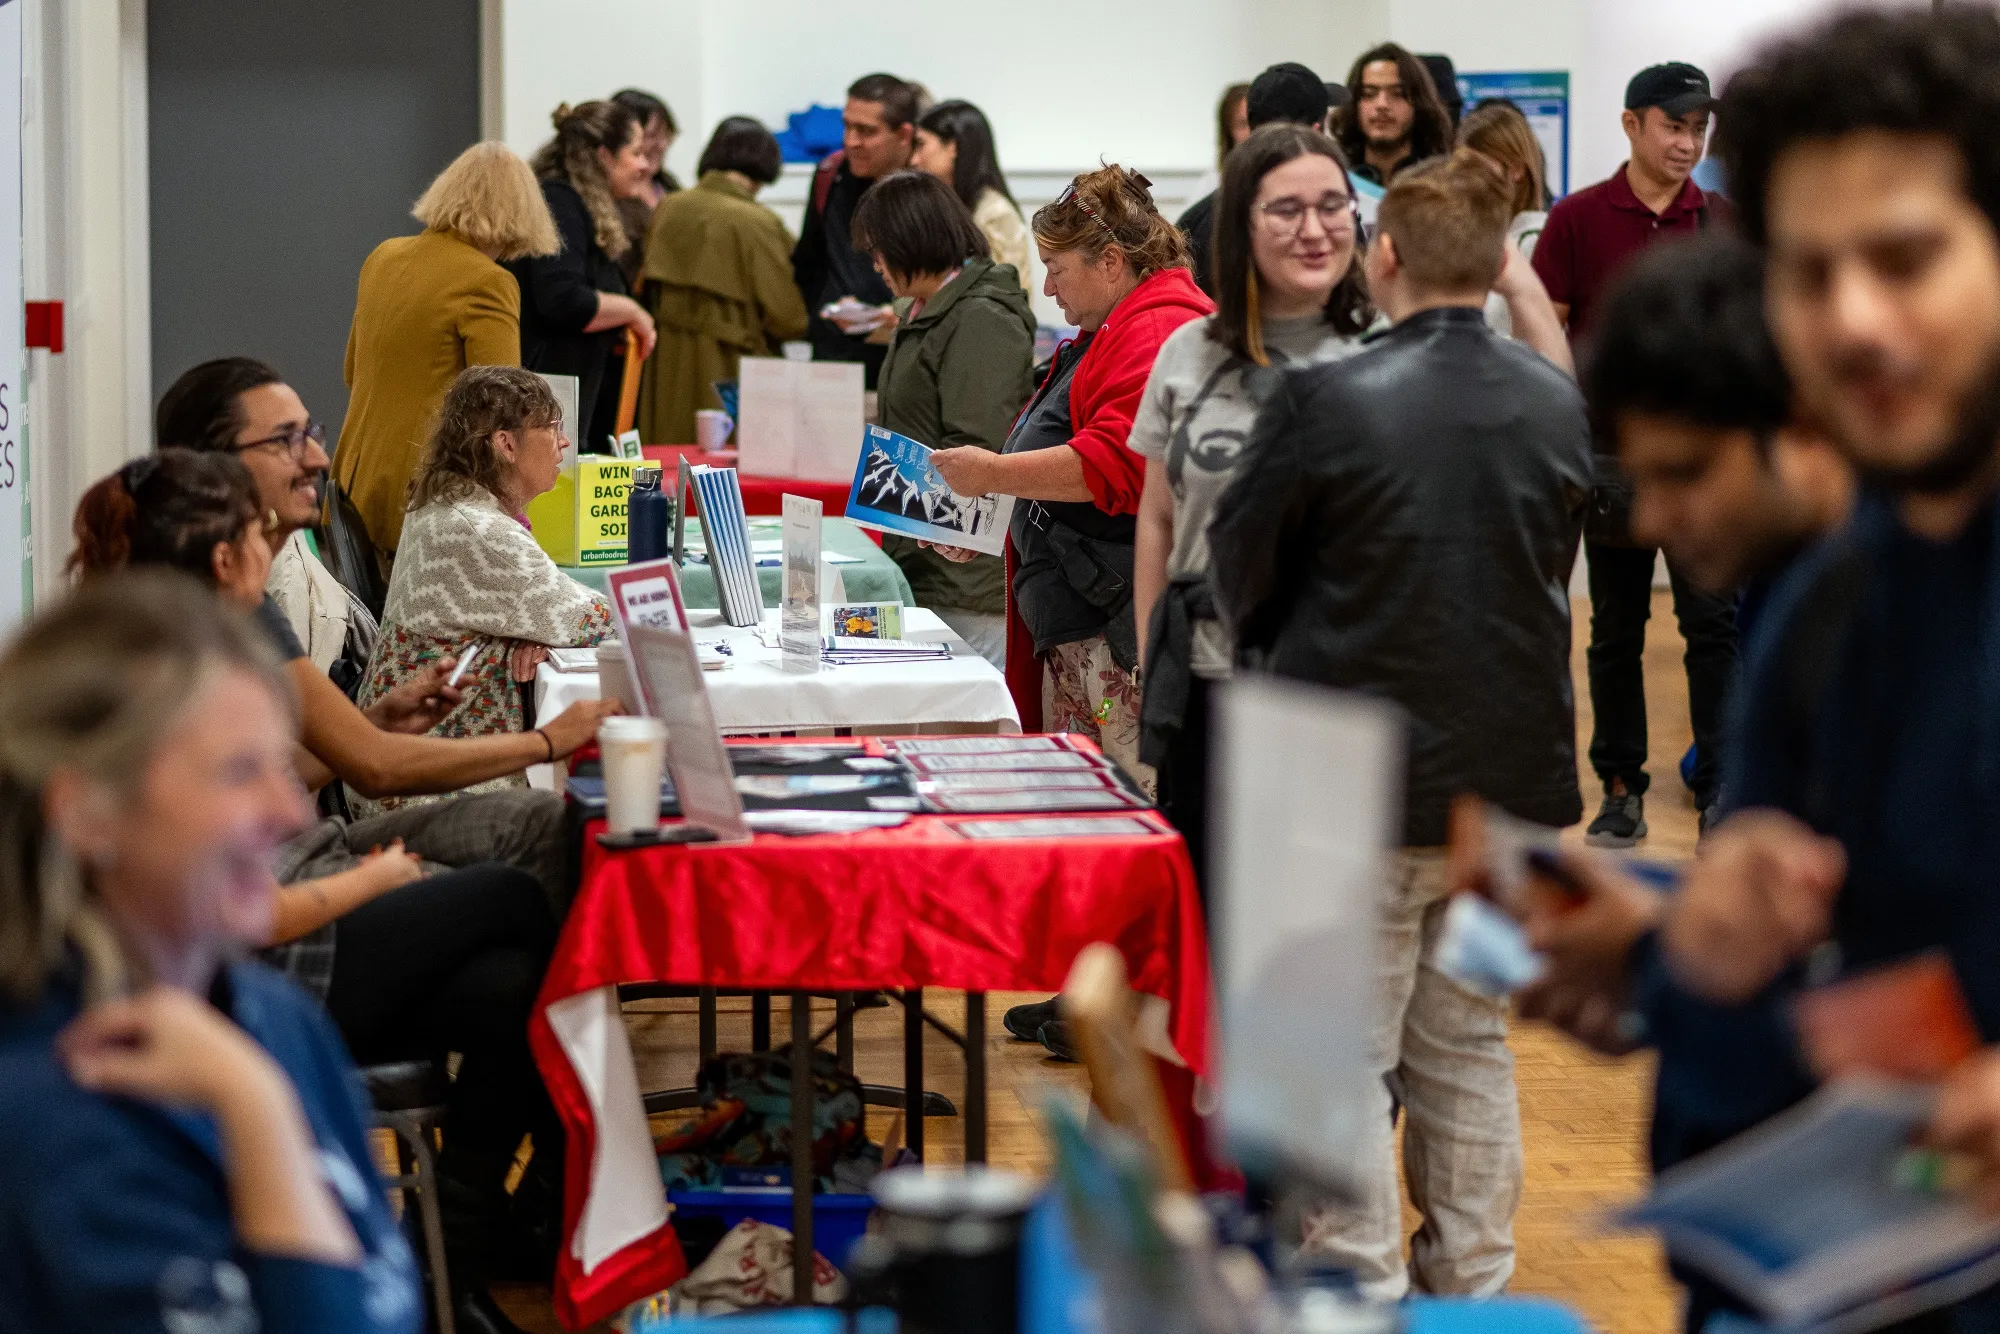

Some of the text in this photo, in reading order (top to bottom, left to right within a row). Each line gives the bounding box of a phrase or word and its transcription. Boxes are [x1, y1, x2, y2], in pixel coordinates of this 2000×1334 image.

[600, 466, 630, 479] WIN
[594, 485, 623, 498] BAG
[590, 504, 628, 517] GARD
[600, 523, 627, 536] SOI
[583, 550, 628, 560] urbanfoodresi
